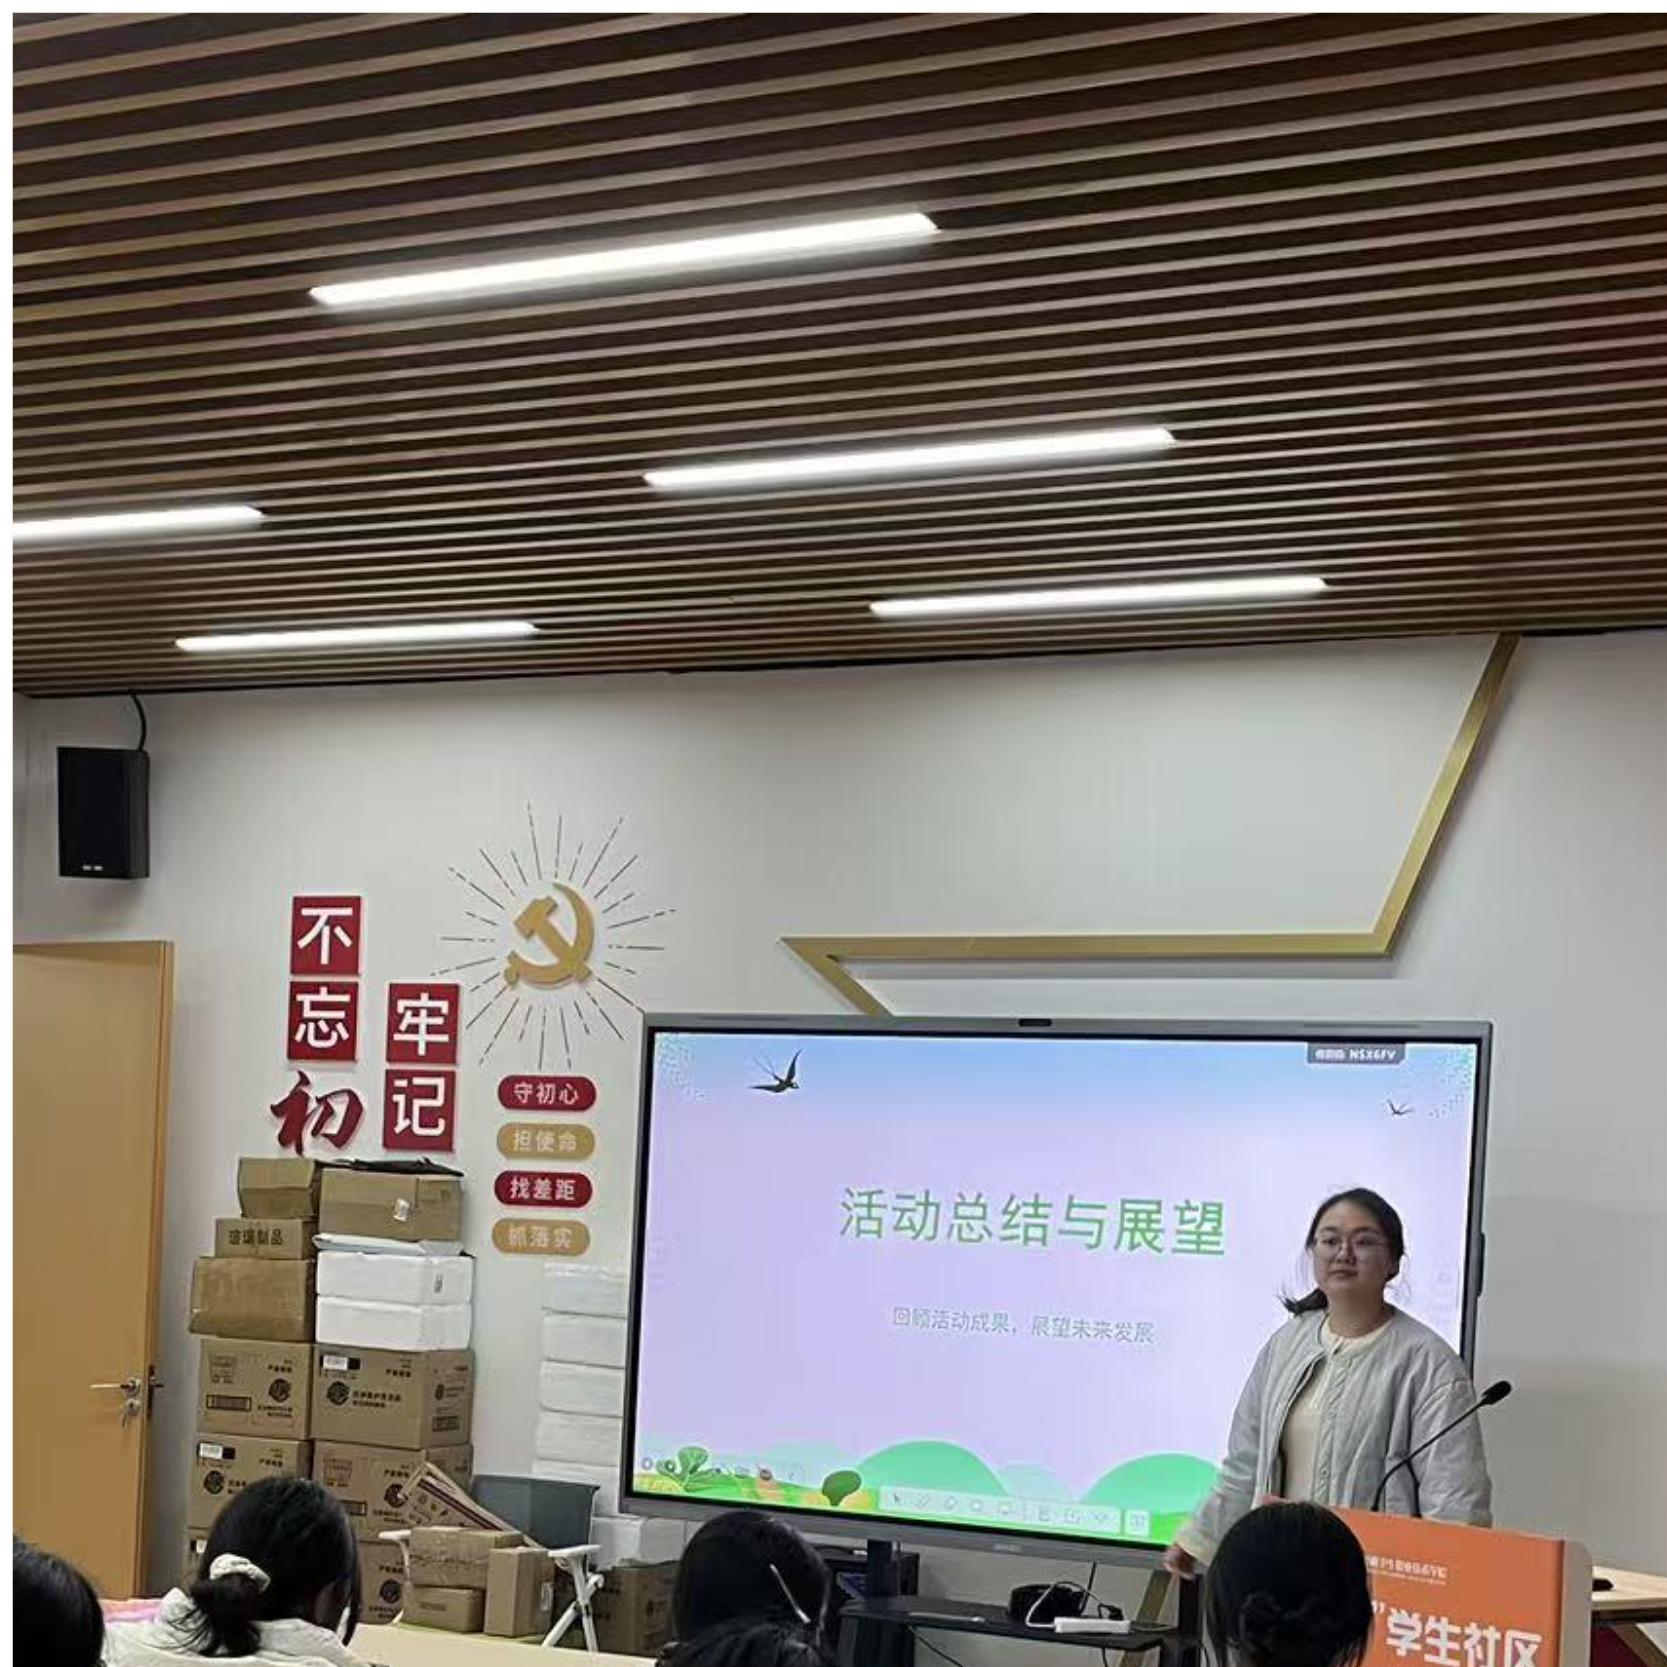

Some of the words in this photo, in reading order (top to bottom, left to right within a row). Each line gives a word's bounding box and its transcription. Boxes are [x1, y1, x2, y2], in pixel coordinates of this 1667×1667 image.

[392, 992, 449, 1137] 牢记
[513, 1081, 579, 1105] 守初心
[513, 1130, 578, 1152] 担使命
[509, 1175, 576, 1201] 找差距
[839, 1186, 1225, 1256] 活动总结与展望
[508, 1224, 572, 1249] 抓落实
